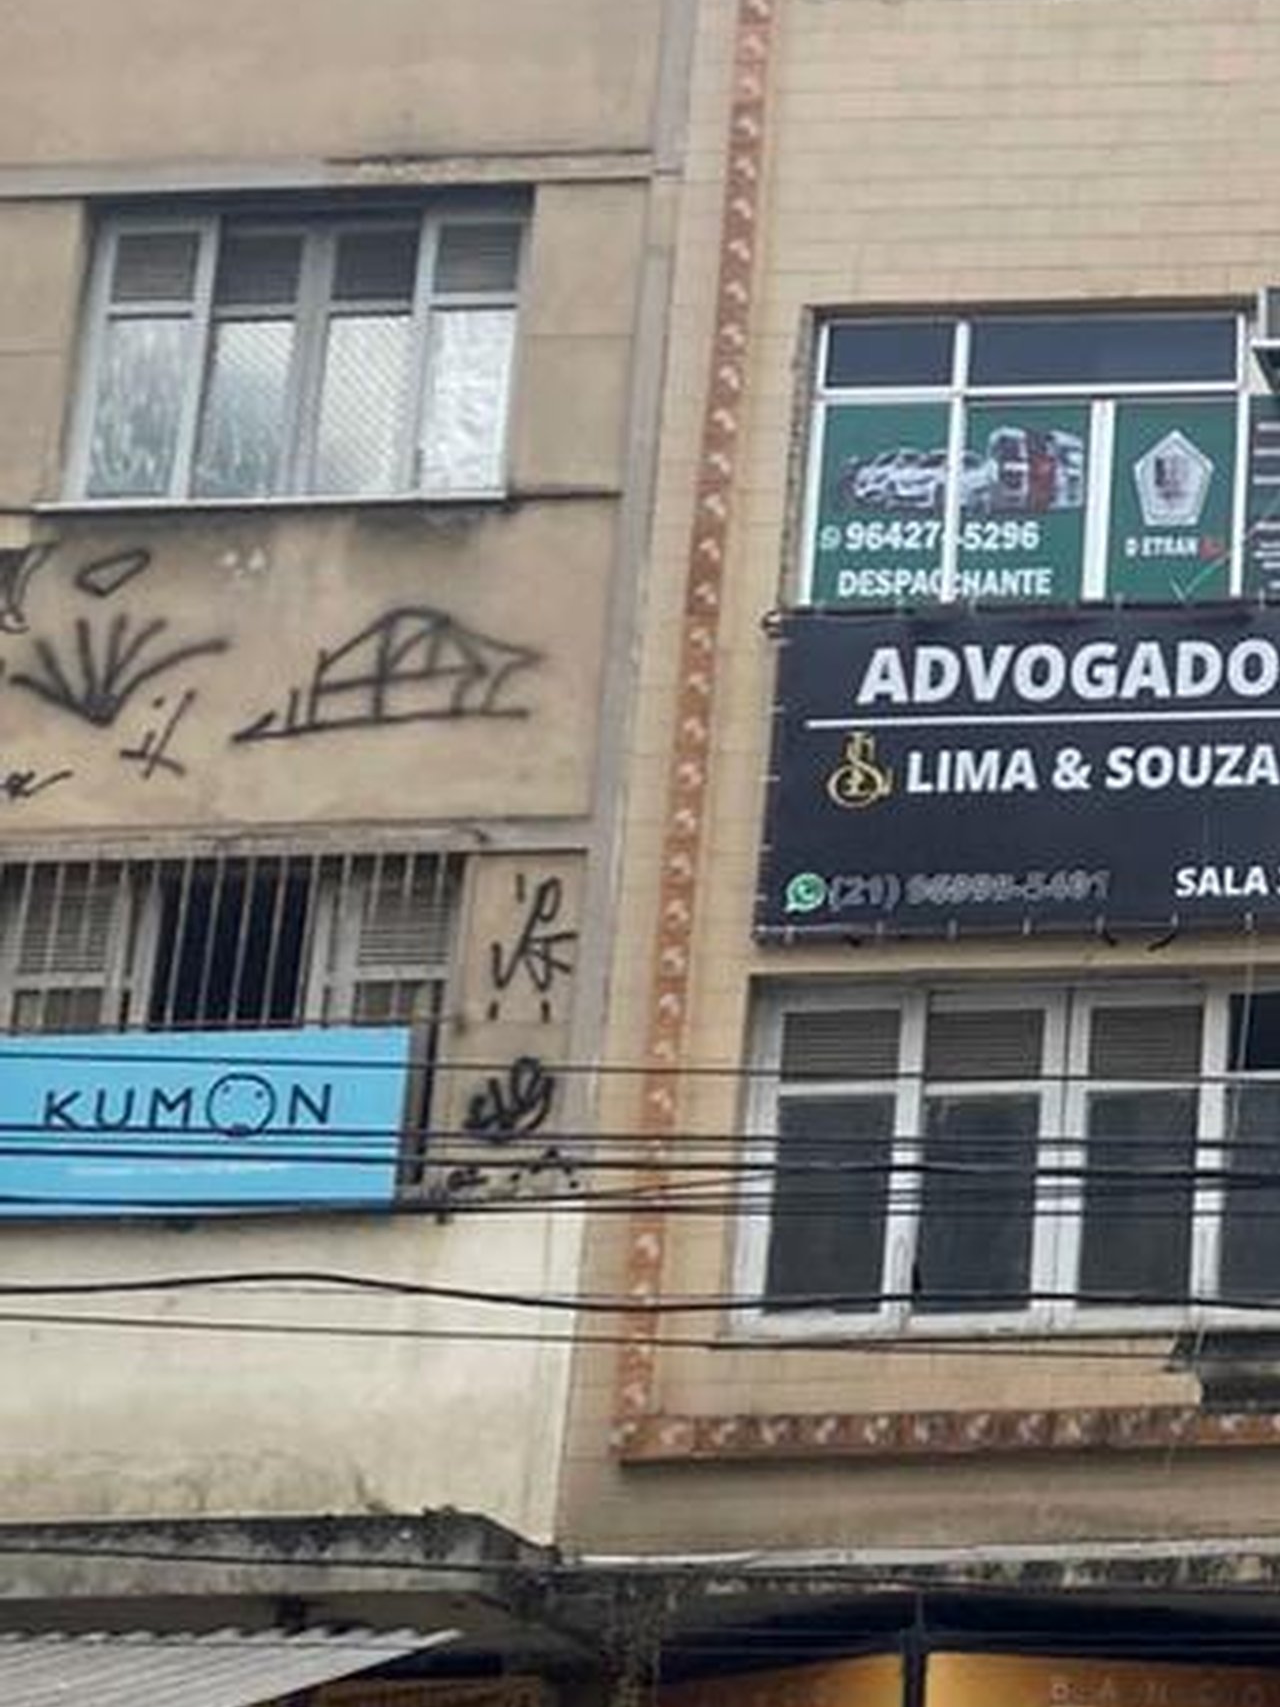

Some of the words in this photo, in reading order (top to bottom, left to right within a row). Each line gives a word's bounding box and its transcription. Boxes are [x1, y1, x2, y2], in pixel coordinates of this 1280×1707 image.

[905, 748, 1039, 794] LIMA
[1052, 747, 1092, 791] &
[1175, 867, 1272, 898] SALA
[42, 1072, 332, 1137] KUMON
